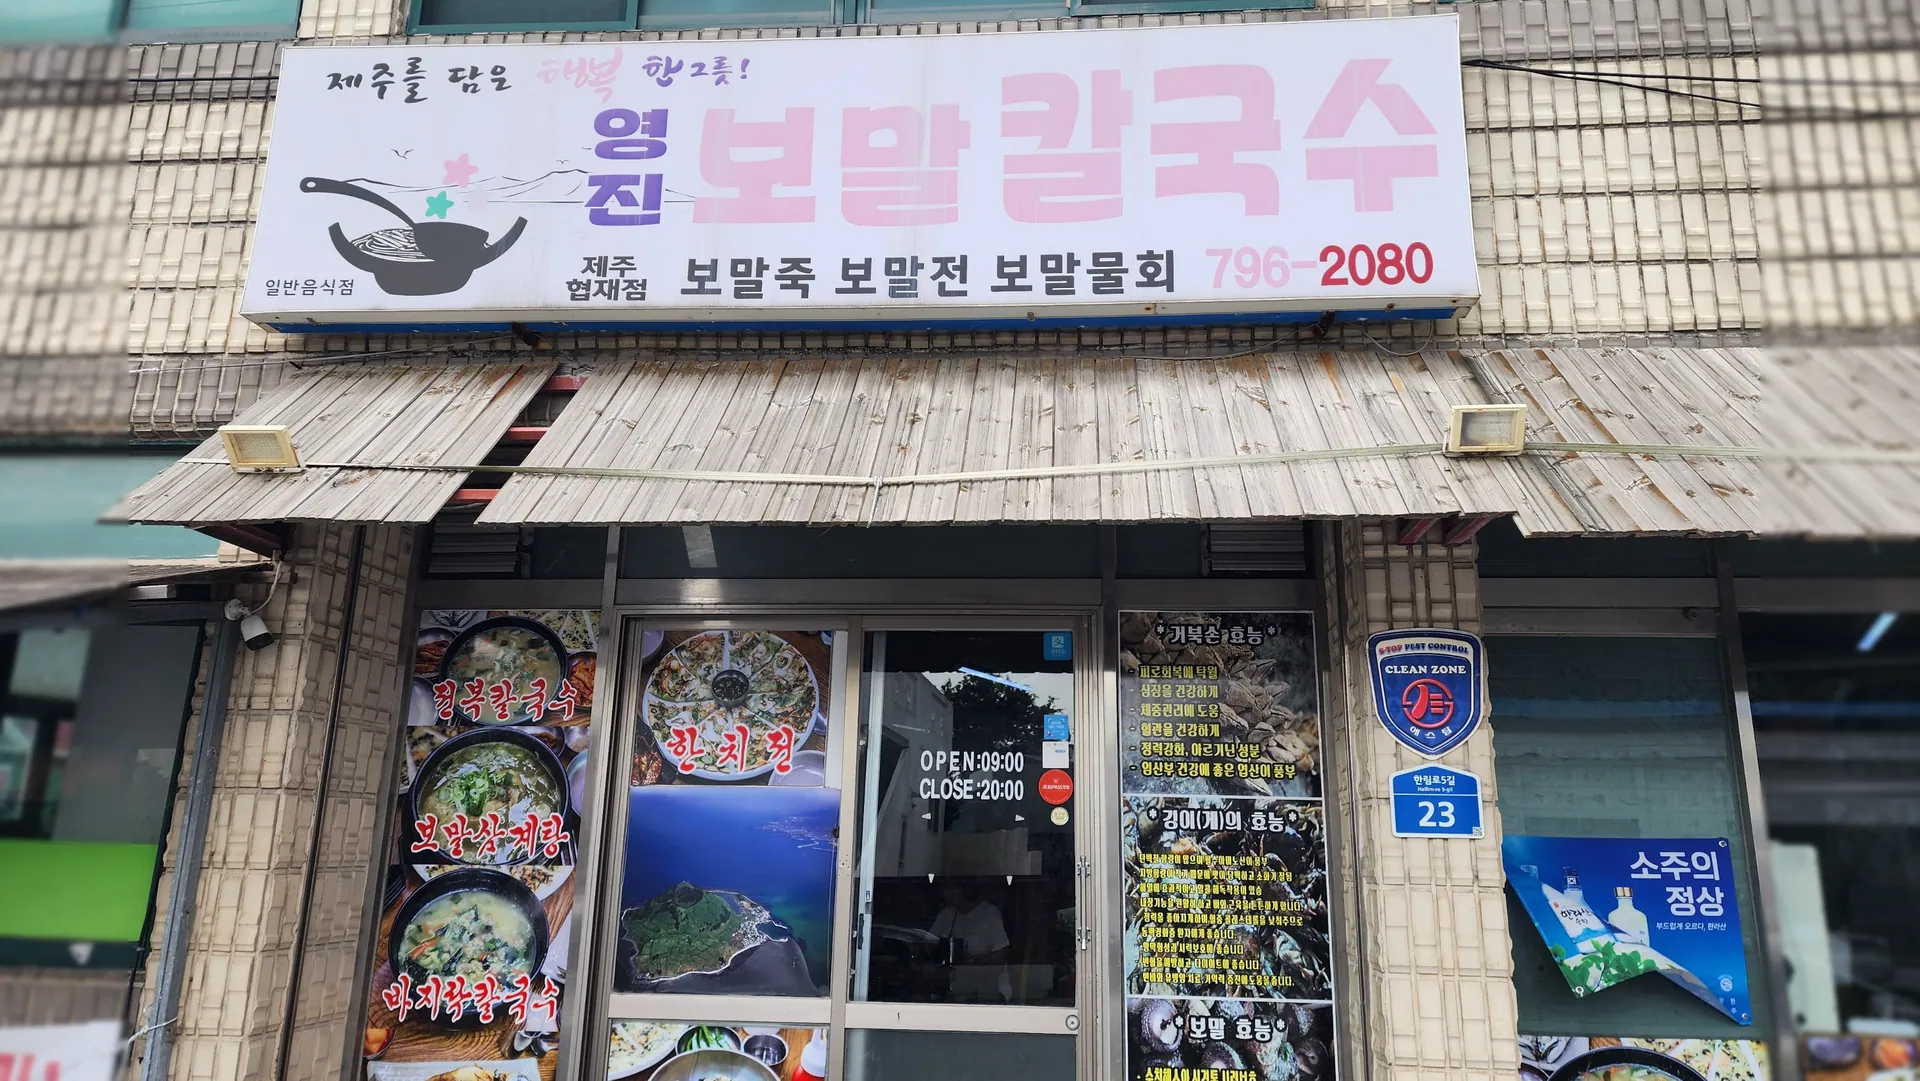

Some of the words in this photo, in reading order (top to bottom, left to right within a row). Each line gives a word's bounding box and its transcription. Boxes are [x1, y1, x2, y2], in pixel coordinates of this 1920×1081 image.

[327, 56, 429, 104] 제주를
[448, 60, 513, 93] 담은
[537, 48, 623, 103] 행복
[692, 57, 1439, 228] 보말칼국수
[581, 255, 637, 276] 제주
[680, 257, 816, 300] 보말죽
[834, 253, 969, 299] 보말전
[990, 248, 1177, 296] 보말물회
[1205, 241, 1434, 291] 796-2080
[265, 277, 355, 298] 일반음식점
[565, 277, 648, 302] 협재점
[1171, 625, 1221, 645] 거북손
[1229, 626, 1263, 646] 효능
[1404, 642, 1427, 651] PEST
[1427, 642, 1469, 655] CONTROL
[1139, 665, 1194, 679] 피로회복에
[1196, 665, 1219, 680] 탁월
[1384, 665, 1428, 674] CLEAN
[1431, 665, 1466, 674] ZONE
[432, 678, 578, 723] 전복칼국수
[1140, 684, 1174, 698] 심장을
[1175, 684, 1219, 699] 건강하게
[1140, 703, 1195, 717] 체중관리에
[1197, 704, 1220, 718] 도움
[1141, 723, 1173, 737] 혈관을
[1176, 723, 1220, 737] 건강하게
[1191, 743, 1237, 757] 아르기닌
[1238, 744, 1260, 758] 성분
[1141, 762, 1175, 776] 임산부
[1177, 763, 1210, 777] 건강에
[1212, 763, 1234, 777] 좋은
[1237, 764, 1271, 778] 엽산이
[1273, 764, 1296, 779] 풍부
[1413, 774, 1456, 786] 한림로5길
[1162, 809, 1242, 831] 깅이(게)의
[1250, 811, 1285, 832] 효능
[1418, 800, 1456, 828] 23
[410, 811, 571, 860] 보말삼계탕
[1629, 850, 1721, 881] 소주의
[1665, 886, 1725, 917] 정상
[1656, 921, 1684, 931] 부드럽게
[1684, 922, 1706, 932] 오르다,
[1707, 922, 1727, 931] 한라산
[382, 973, 560, 1025] 바지락칼국수
[1190, 1015, 1225, 1040] 보말
[1235, 1016, 1272, 1041] 효능
